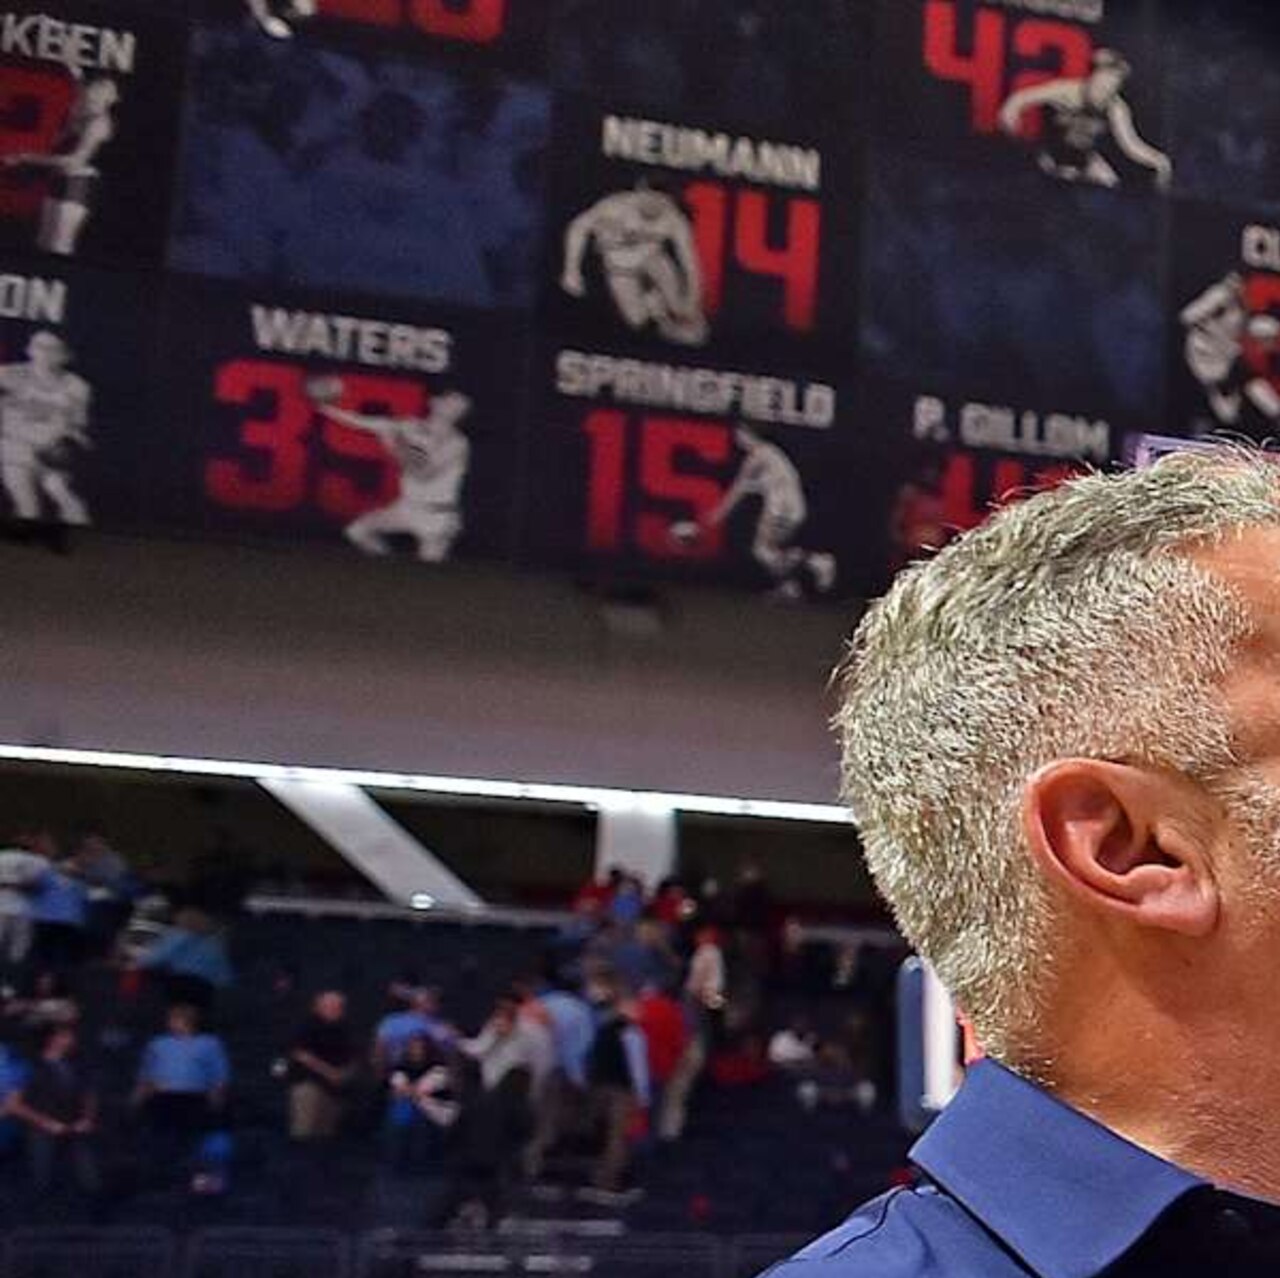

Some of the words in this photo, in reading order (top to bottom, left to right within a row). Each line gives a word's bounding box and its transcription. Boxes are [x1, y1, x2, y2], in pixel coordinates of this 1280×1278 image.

[603, 115, 820, 190] NEUMANN
[682, 180, 822, 331] 14
[250, 303, 451, 374] WATERS
[556, 349, 836, 430] SPRINGFIELD
[204, 355, 430, 515] 35
[584, 408, 734, 561] 15
